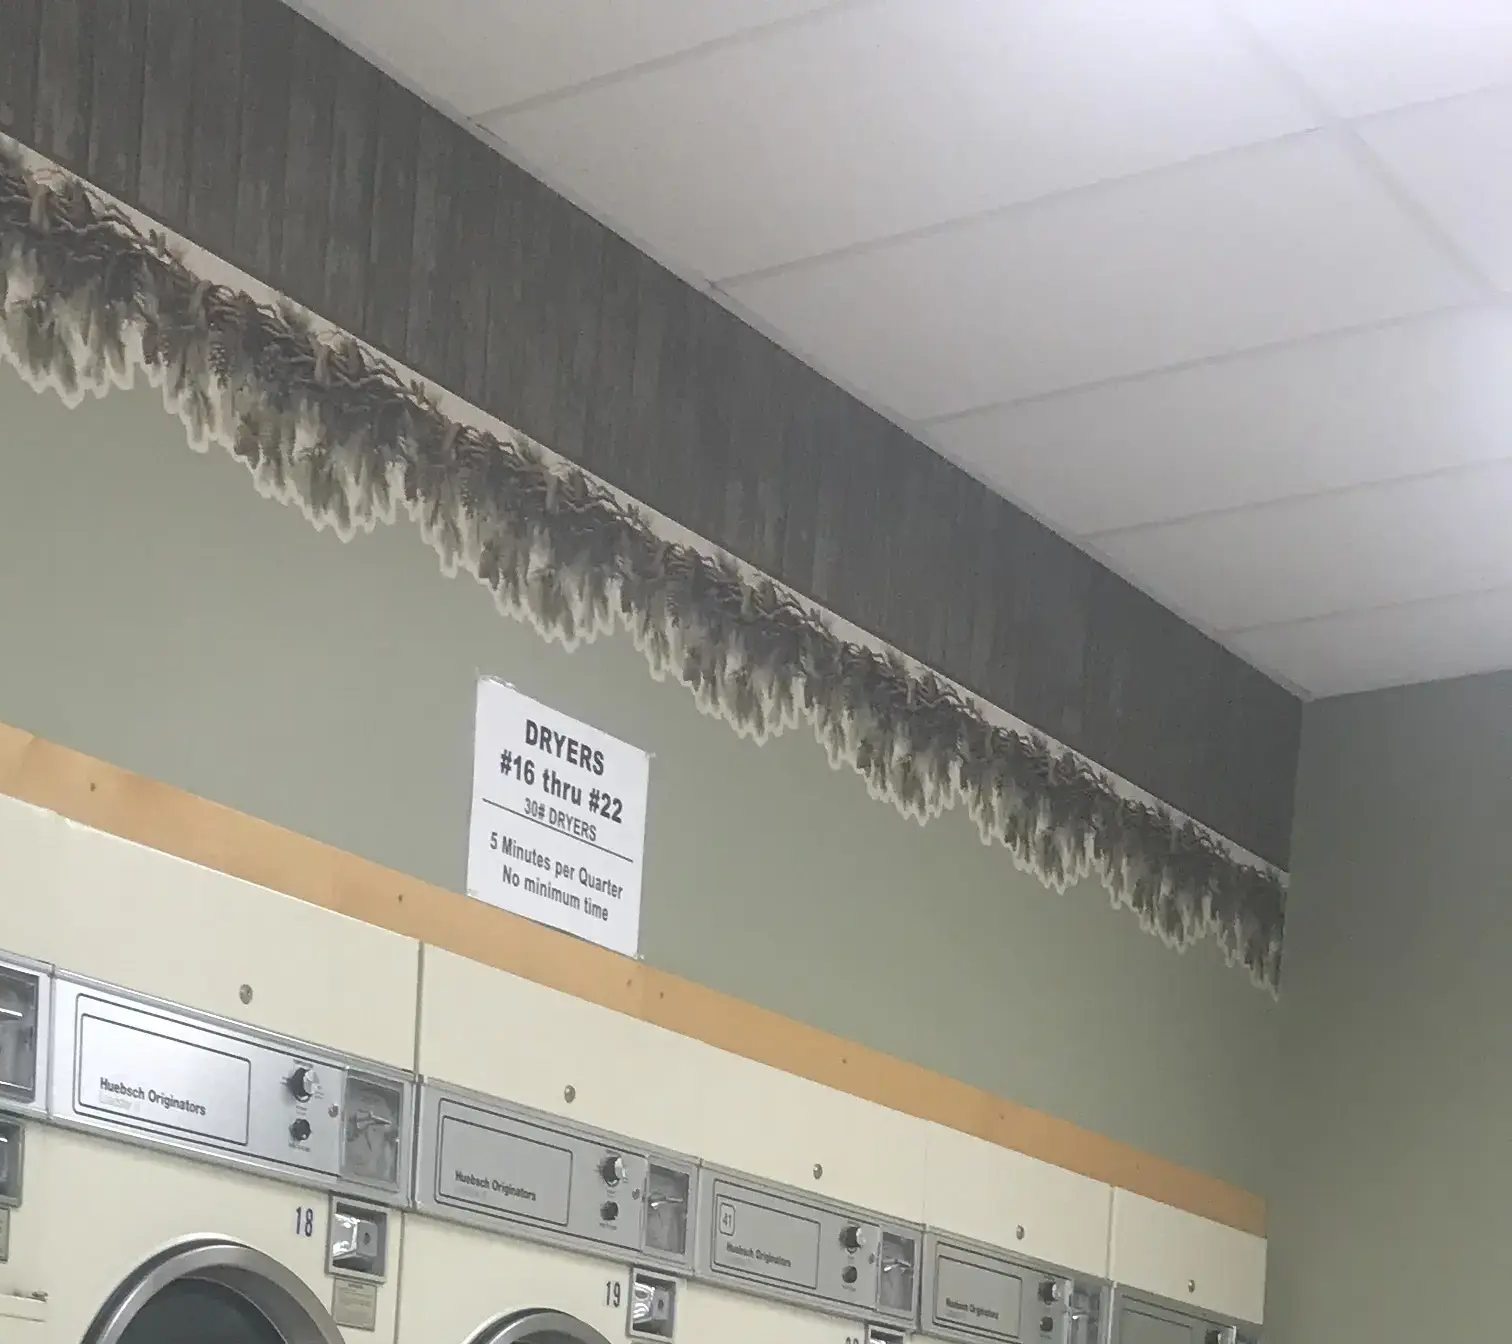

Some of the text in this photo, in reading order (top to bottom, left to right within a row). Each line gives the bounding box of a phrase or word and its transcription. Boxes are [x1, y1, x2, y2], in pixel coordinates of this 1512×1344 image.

[525, 718, 604, 776] DRYERS
[500, 749, 623, 824] #16 thru #22
[524, 797, 597, 842] 30# DRYERS
[489, 831, 623, 900] 5 Minutes per Quarter
[502, 864, 609, 921] No minimum time
[100, 1076, 145, 1100] Huebsch
[148, 1089, 206, 1116] Originators
[295, 1206, 314, 1237] 18
[605, 1281, 621, 1307] 19
